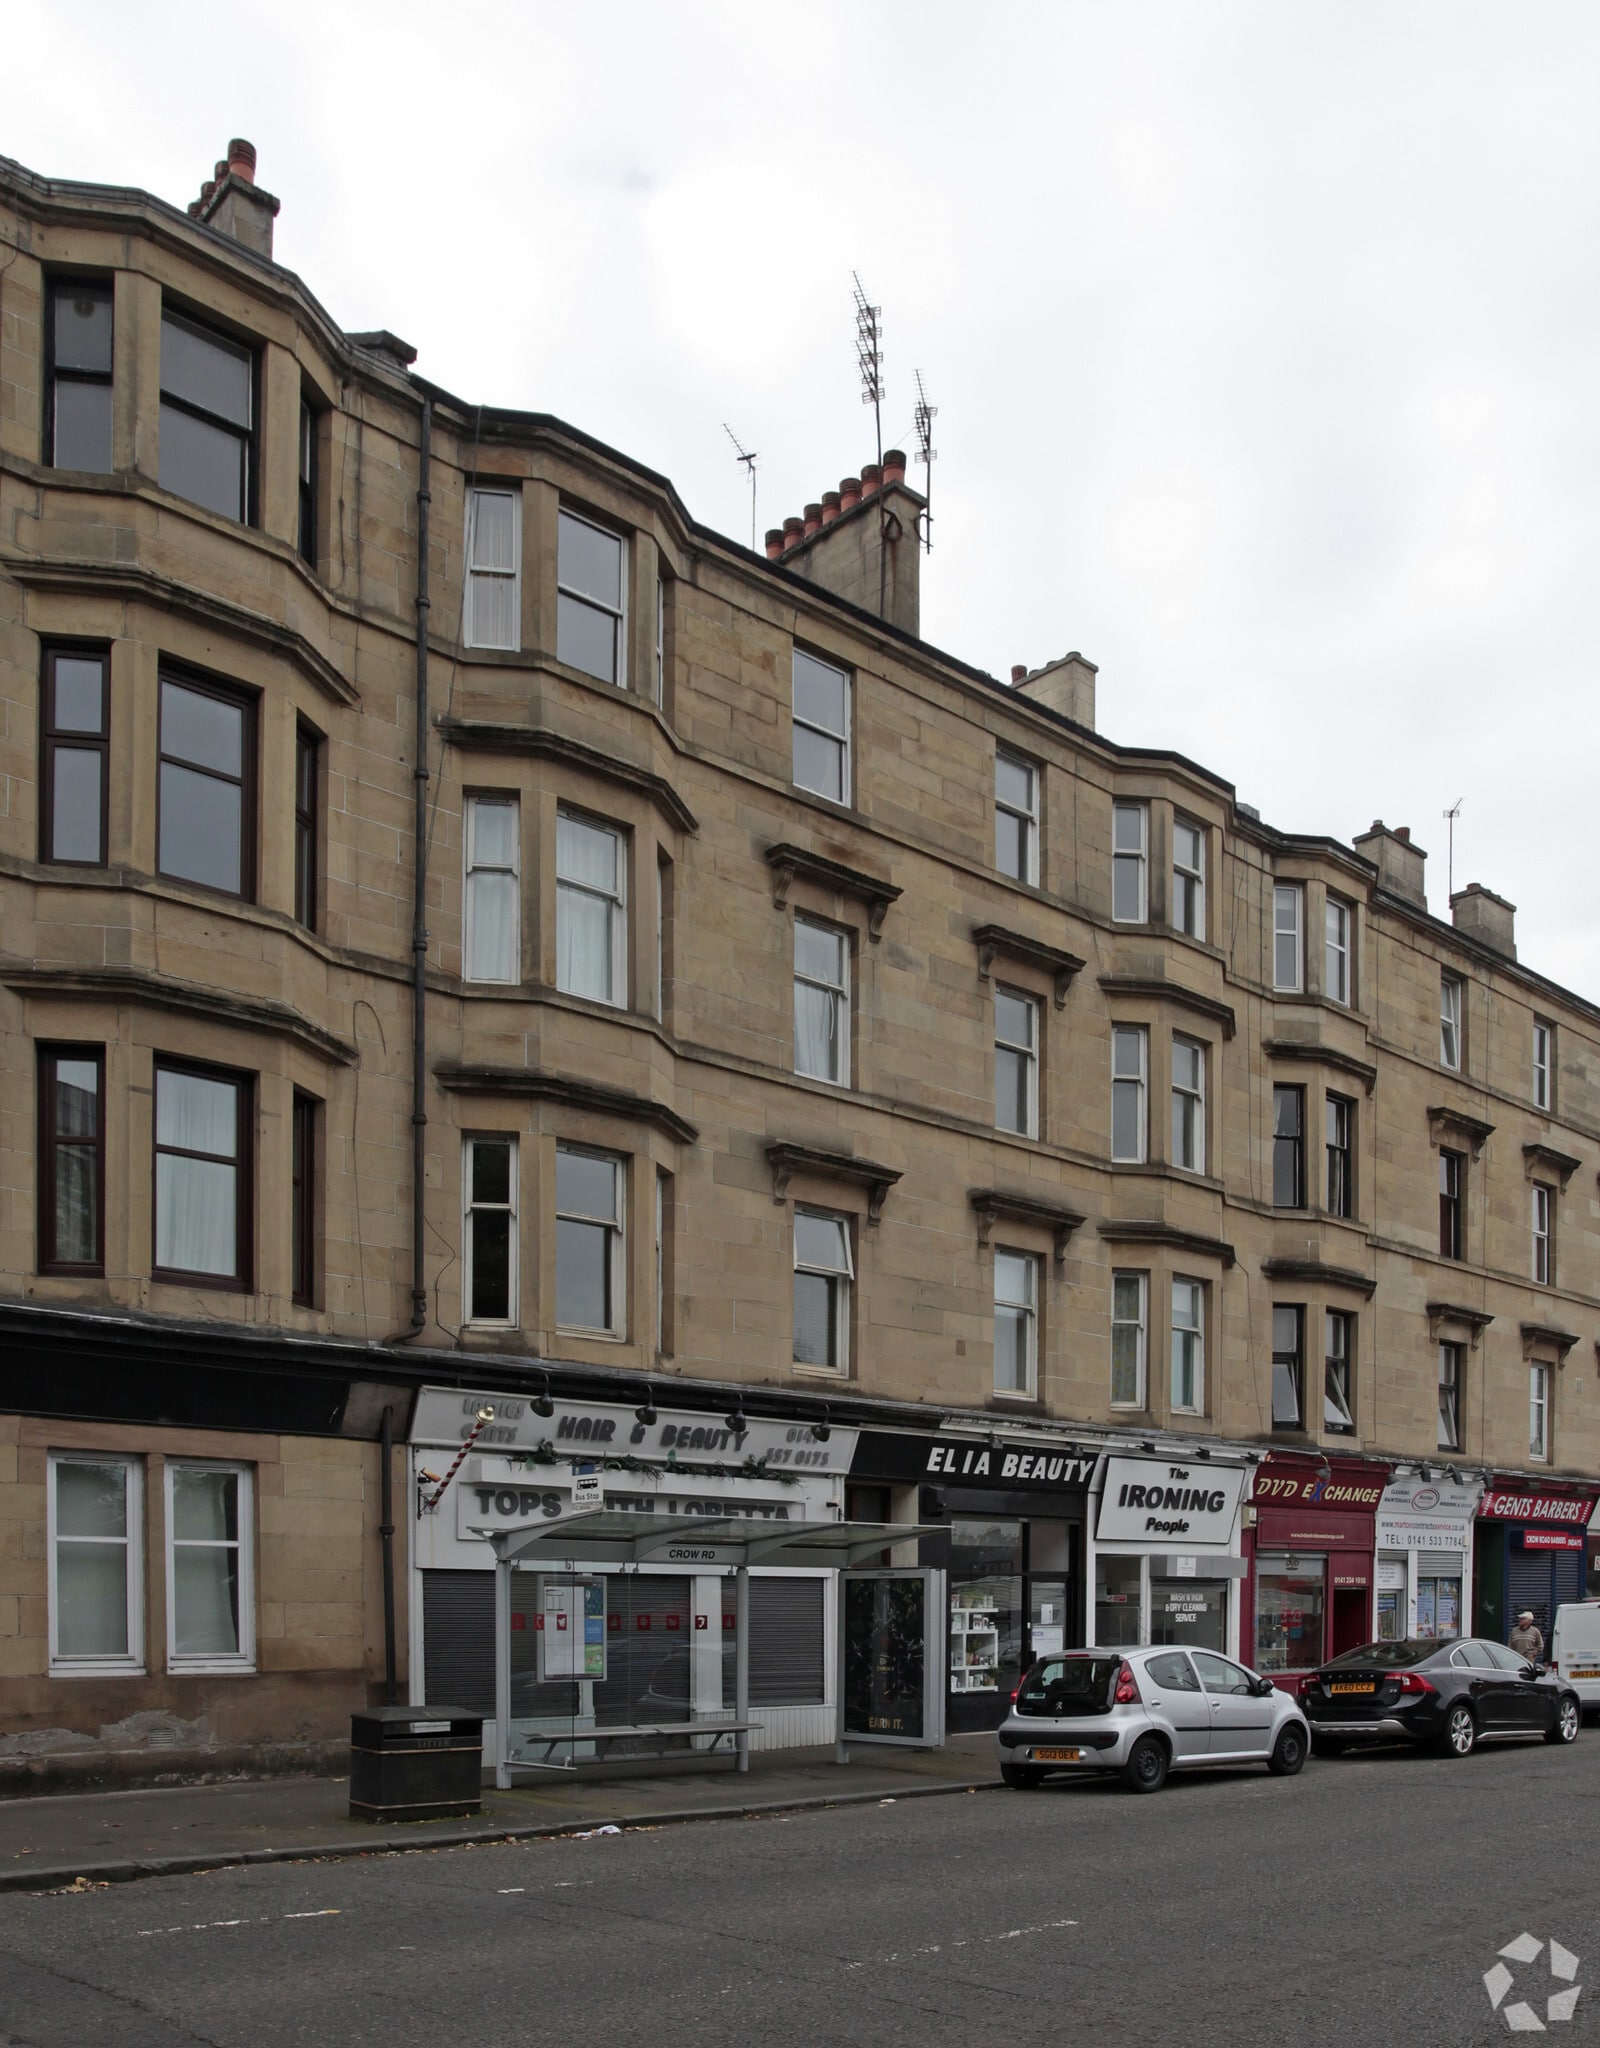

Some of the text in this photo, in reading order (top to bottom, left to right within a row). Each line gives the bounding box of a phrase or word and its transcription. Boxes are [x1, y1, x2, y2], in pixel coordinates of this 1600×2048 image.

[460, 1423, 519, 1442] GNTS
[556, 1416, 749, 1452] HAIR & BEAUTY
[926, 1447, 1094, 1483] ELIA BEAUTY
[1169, 1467, 1190, 1480] The
[575, 1492, 600, 1501] Bus Stop
[1118, 1484, 1226, 1513] IRONING
[1256, 1478, 1380, 1503] DVD EXCHANGE
[475, 1488, 562, 1518] TOPS
[1494, 1495, 1582, 1520] GENTS BARBERS
[1145, 1517, 1190, 1535] People
[1385, 1534, 1462, 1546] TEL: 0141 533 7784
[669, 1549, 715, 1559] CROW RD
[1175, 1613, 1197, 1622] SERVICE
[868, 1717, 904, 1729] EARN IT.
